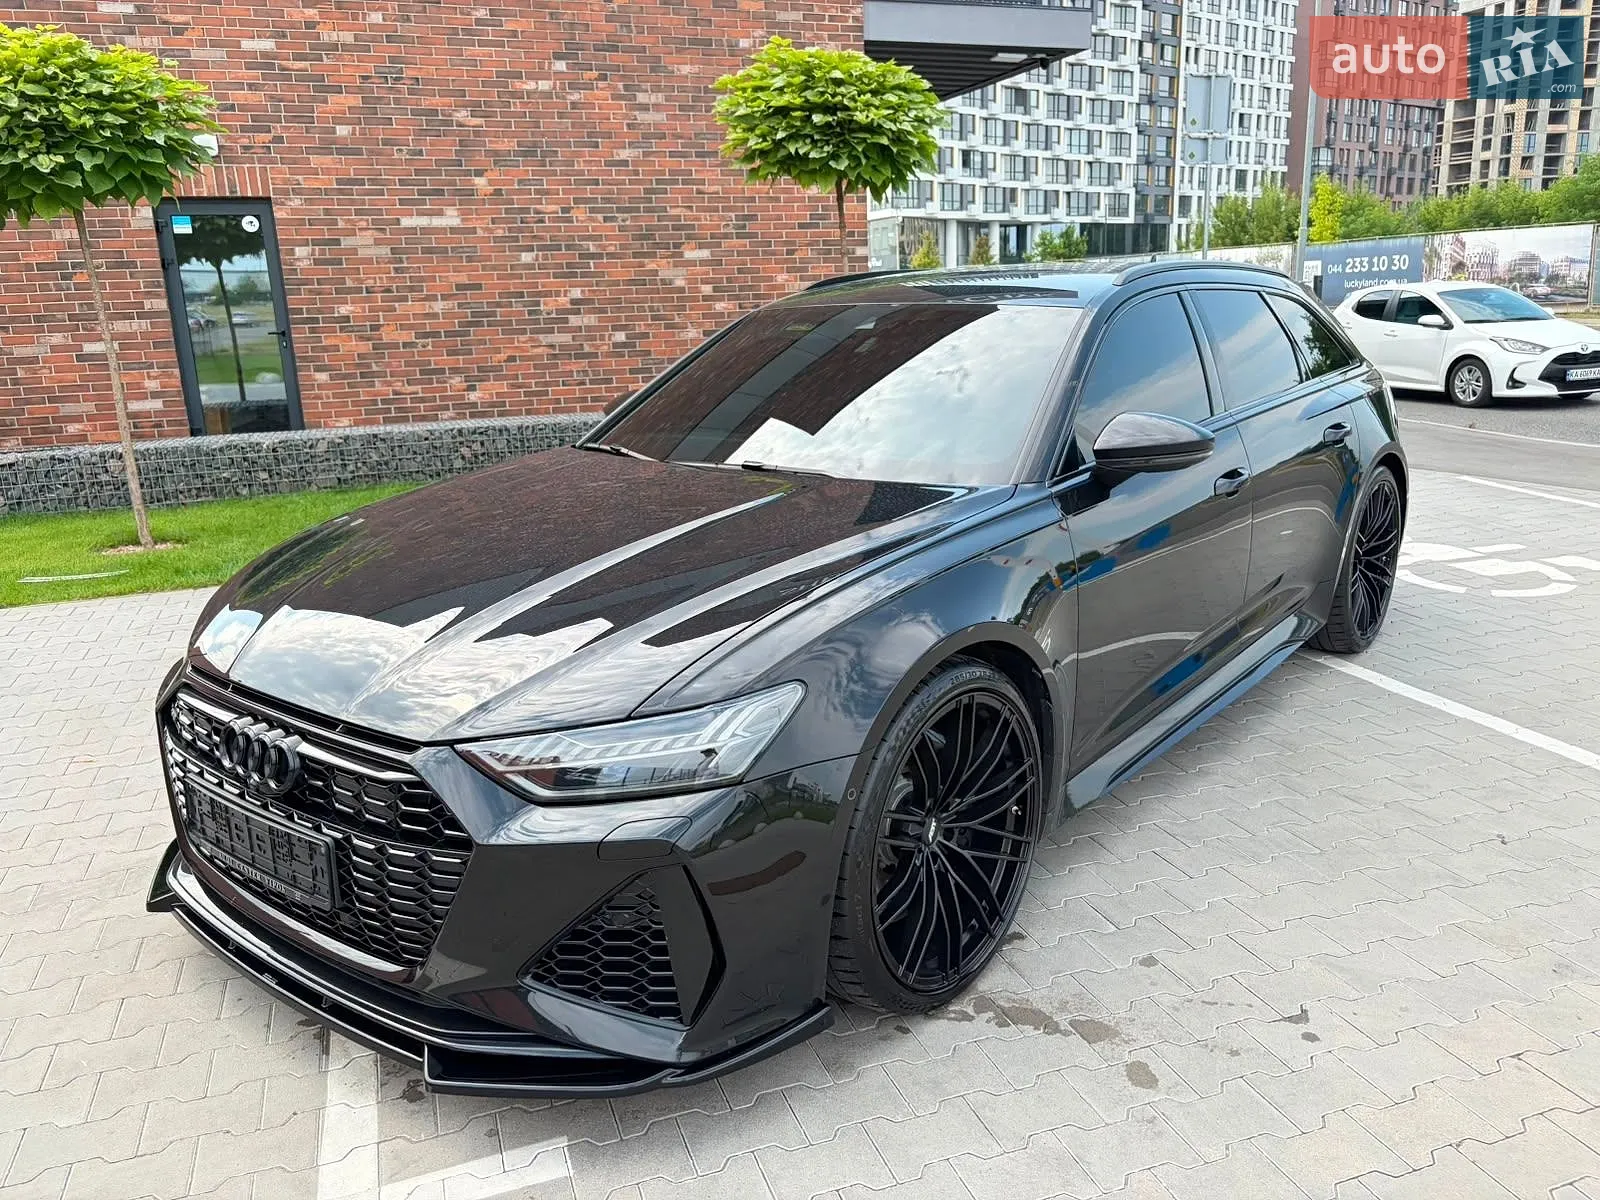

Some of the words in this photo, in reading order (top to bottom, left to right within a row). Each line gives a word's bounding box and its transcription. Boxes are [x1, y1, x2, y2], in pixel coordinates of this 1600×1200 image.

[1327, 264, 1343, 274] 044
[1345, 256, 1369, 273] 233
[1371, 255, 1388, 272] 10
[1391, 253, 1409, 271] 30
